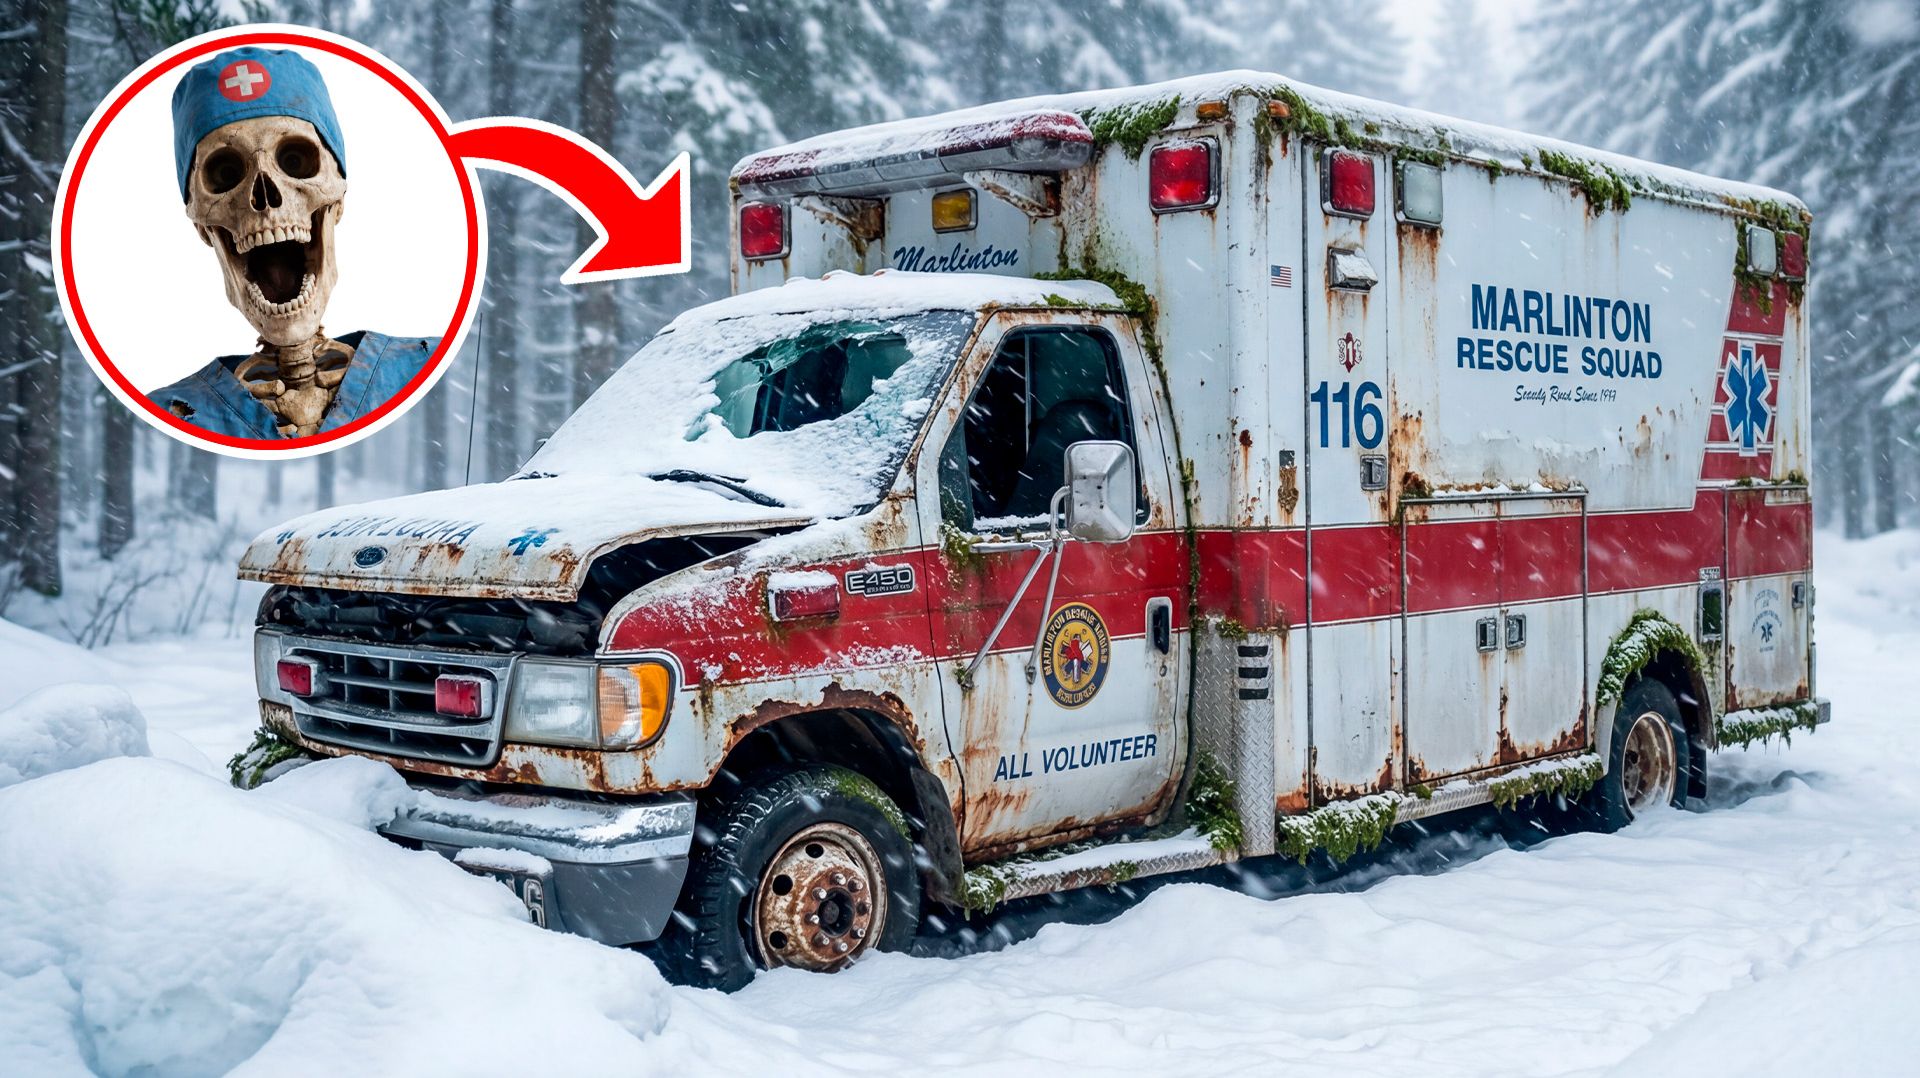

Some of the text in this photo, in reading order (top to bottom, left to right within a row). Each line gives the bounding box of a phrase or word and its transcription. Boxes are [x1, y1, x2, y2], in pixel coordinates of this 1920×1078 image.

[893, 242, 1019, 272] Marlinton
[1471, 283, 1651, 343] MARLINTON
[1457, 337, 1663, 379] RESCUE SQUAD
[1310, 381, 1384, 450] 116
[849, 569, 911, 590] E450
[993, 733, 1158, 783] ALL VOLUNTEER
